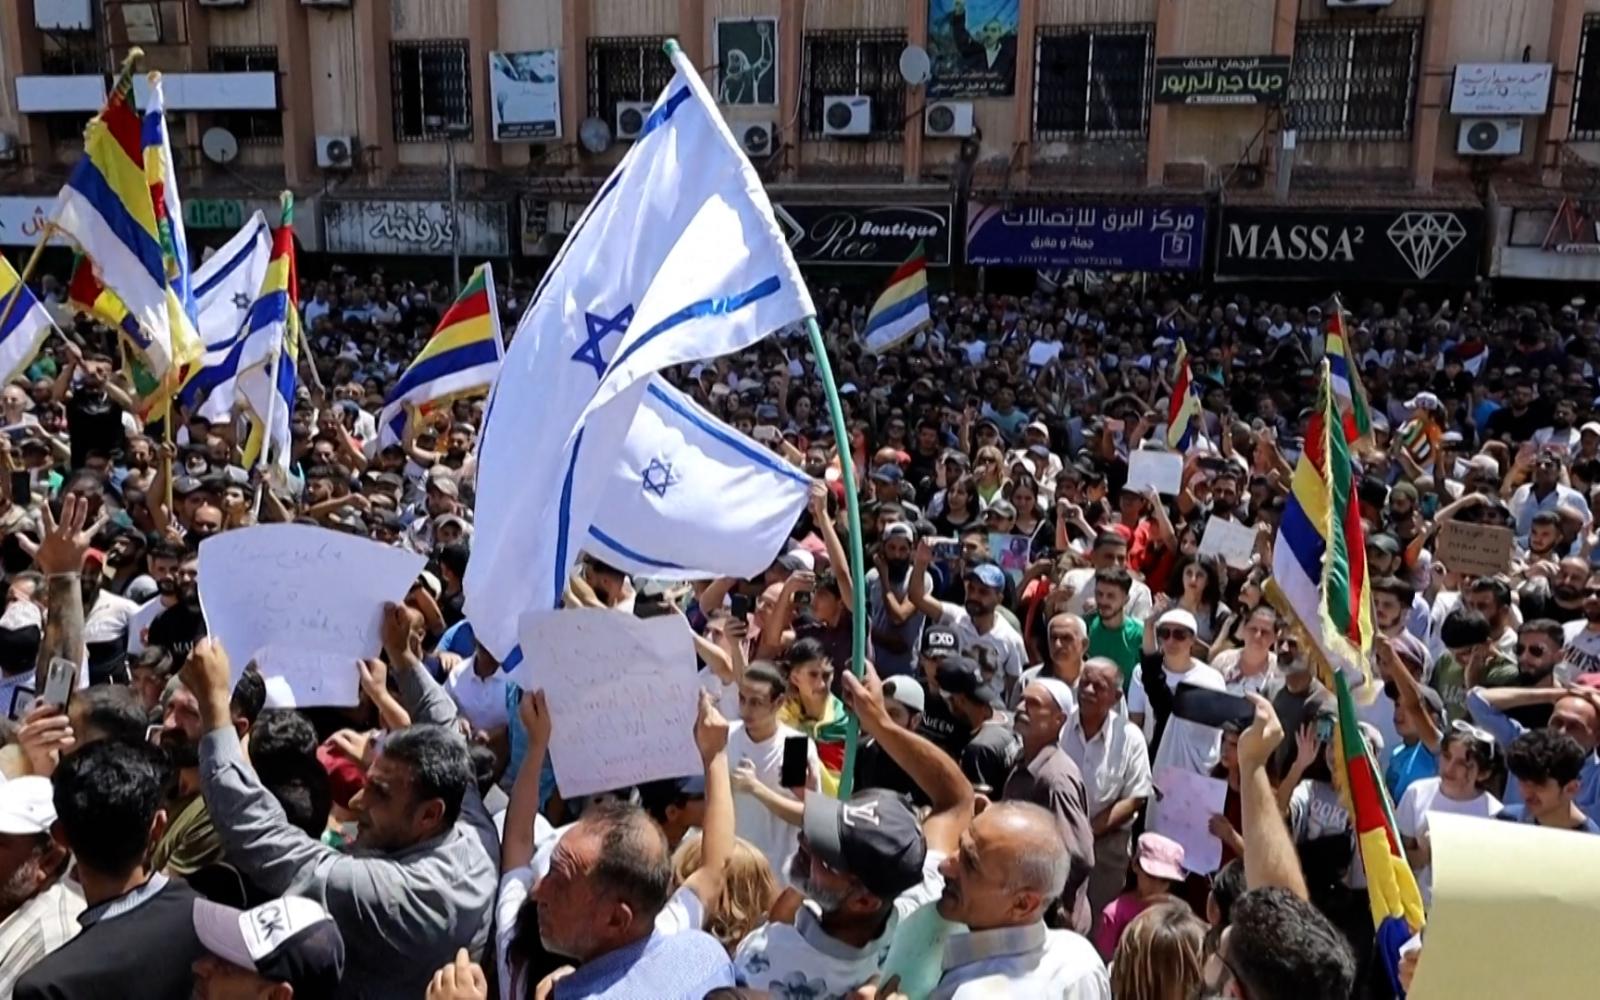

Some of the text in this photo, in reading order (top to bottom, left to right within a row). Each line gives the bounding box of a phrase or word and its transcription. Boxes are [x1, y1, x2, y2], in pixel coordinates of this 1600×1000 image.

[1248, 71, 1283, 93] دينا
[1102, 208, 1144, 232] البرق
[1150, 208, 1195, 231] مركز
[860, 221, 938, 240] Boutique
[1031, 236, 1095, 250] جملة و مفرق
[928, 632, 954, 645] EXD
[923, 716, 954, 734] UEEN
[257, 904, 285, 942] CK
